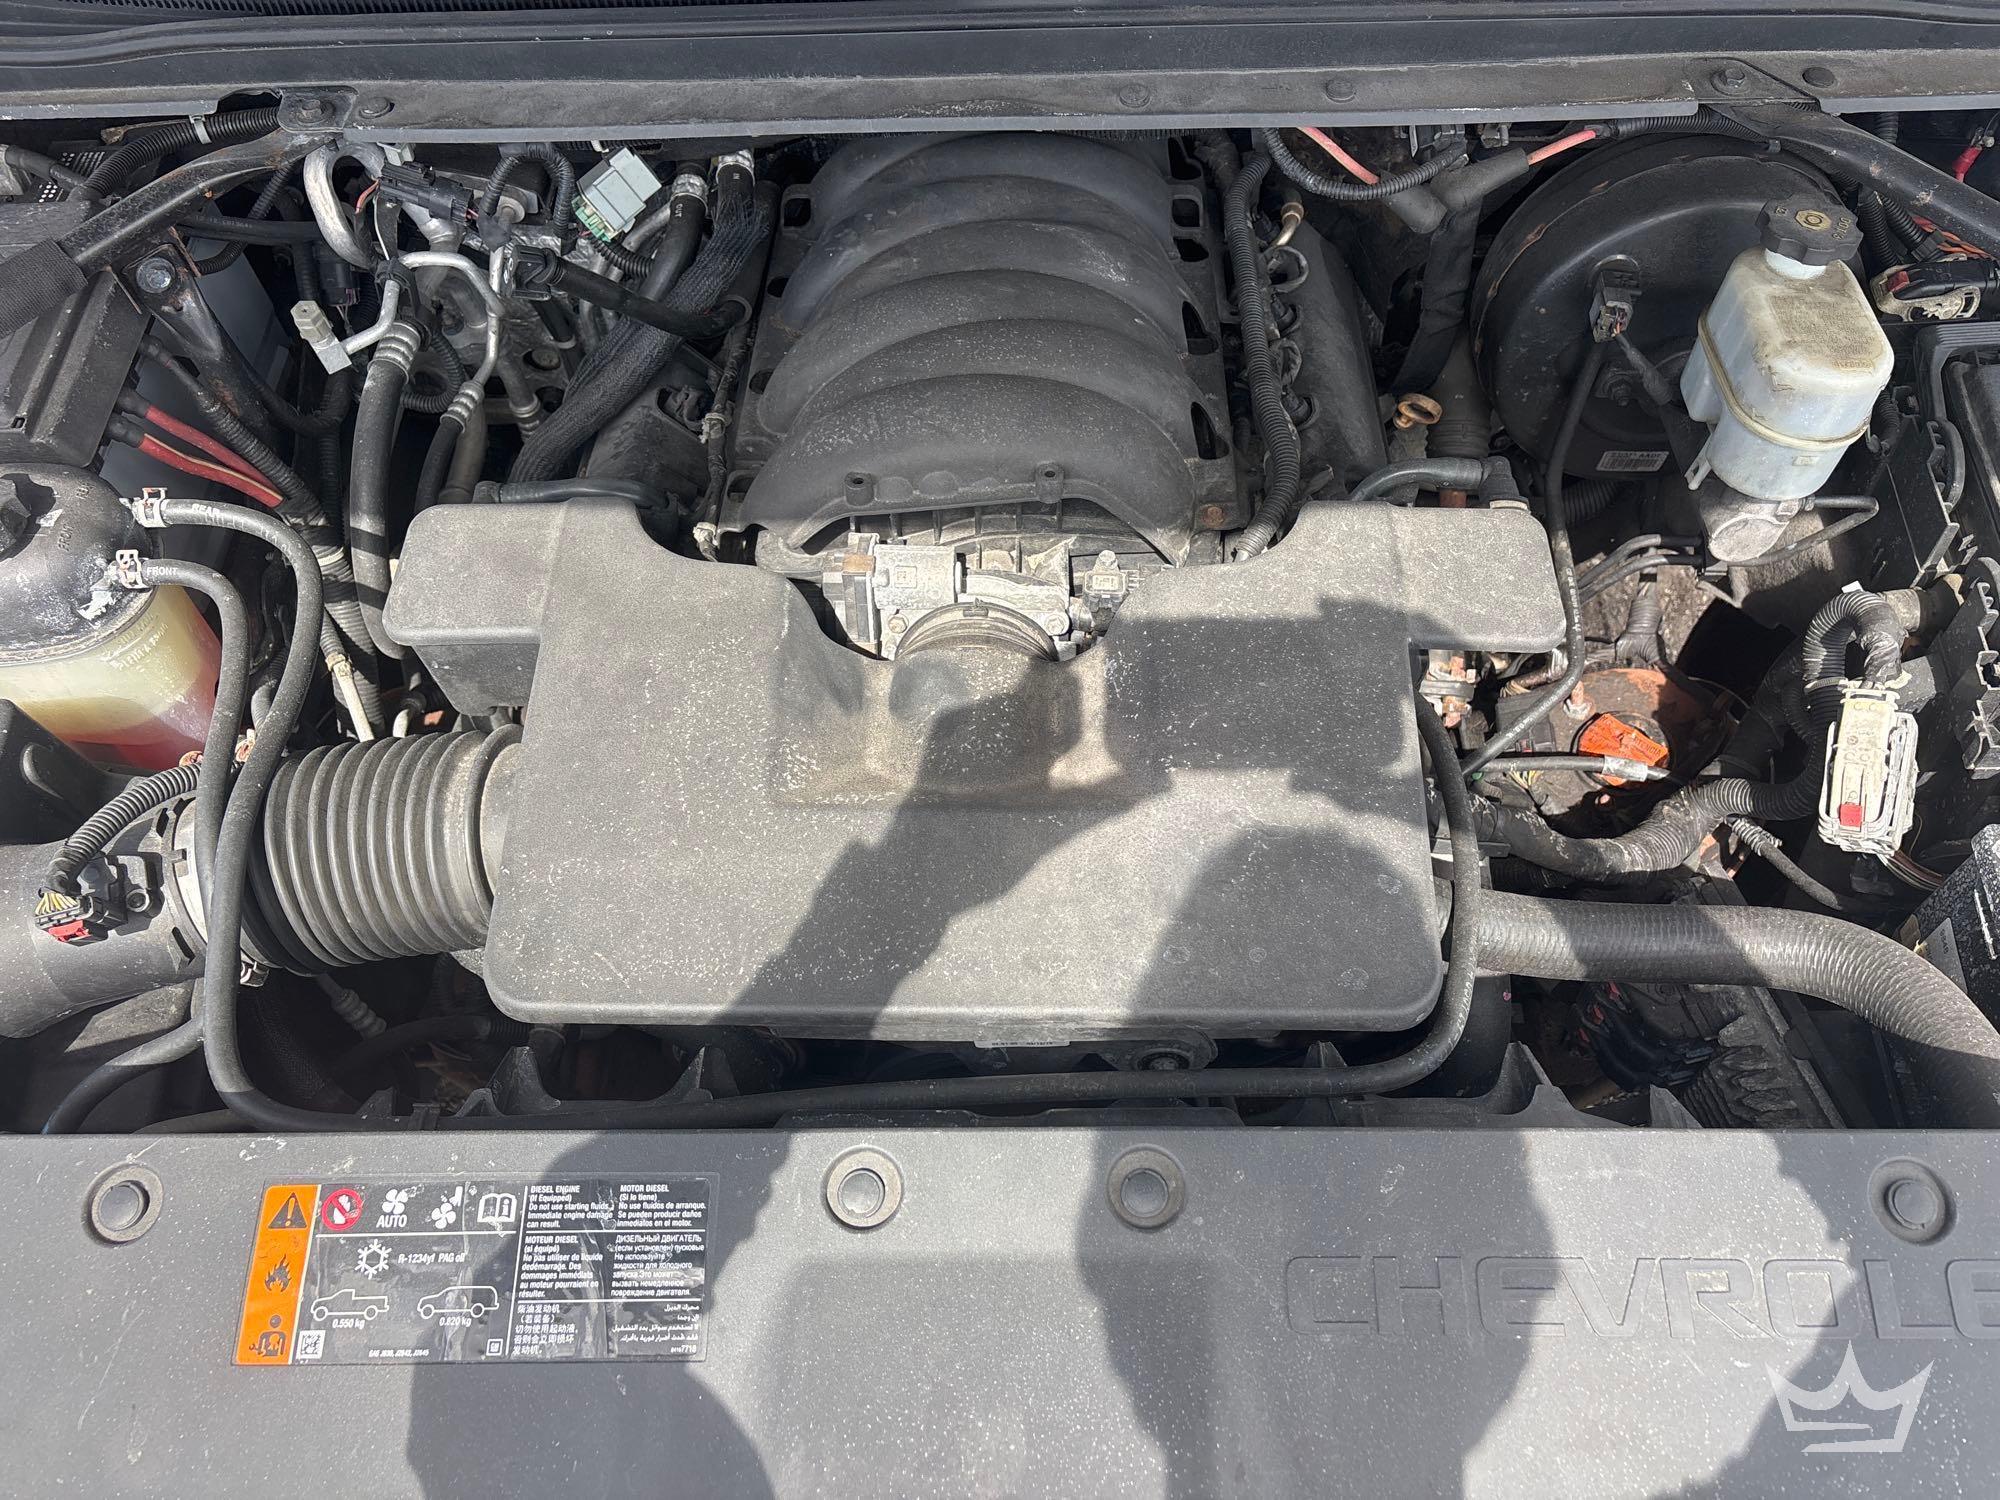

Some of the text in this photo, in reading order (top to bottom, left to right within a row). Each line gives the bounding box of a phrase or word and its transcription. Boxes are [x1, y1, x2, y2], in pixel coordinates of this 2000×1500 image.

[192, 503, 220, 517] REAR
[146, 566, 178, 577] FRONT
[530, 1185, 580, 1194] DIESEL ENGINE
[538, 1194, 572, 1203] Equipped)
[620, 1193, 628, 1202] (Si
[638, 1193, 657, 1202] tiene)
[564, 1202, 589, 1212] starting
[675, 1202, 706, 1210] arranque.
[528, 1211, 613, 1220] Immediate engine damage
[628, 1211, 652, 1219] pueden
[654, 1210, 680, 1219] producir
[376, 1214, 408, 1228] AUTO
[555, 1236, 578, 1244] DIESEL
[616, 1234, 702, 1243] ДИЗЕЛЬНЫЙ ДВИГАТЕЛЬ
[524, 1245, 560, 1254] (si équipé)
[674, 1245, 704, 1253] пусковые
[438, 1252, 454, 1262] PAG
[533, 1254, 545, 1263] pas
[520, 1272, 557, 1281] dommages
[554, 1281, 589, 1290] pourraient
[519, 1290, 545, 1298] résulter.
[517, 1304, 560, 1314] 柴油发动机
[332, 1318, 365, 1330] 0.550 kg
[462, 1316, 472, 1327] kg
